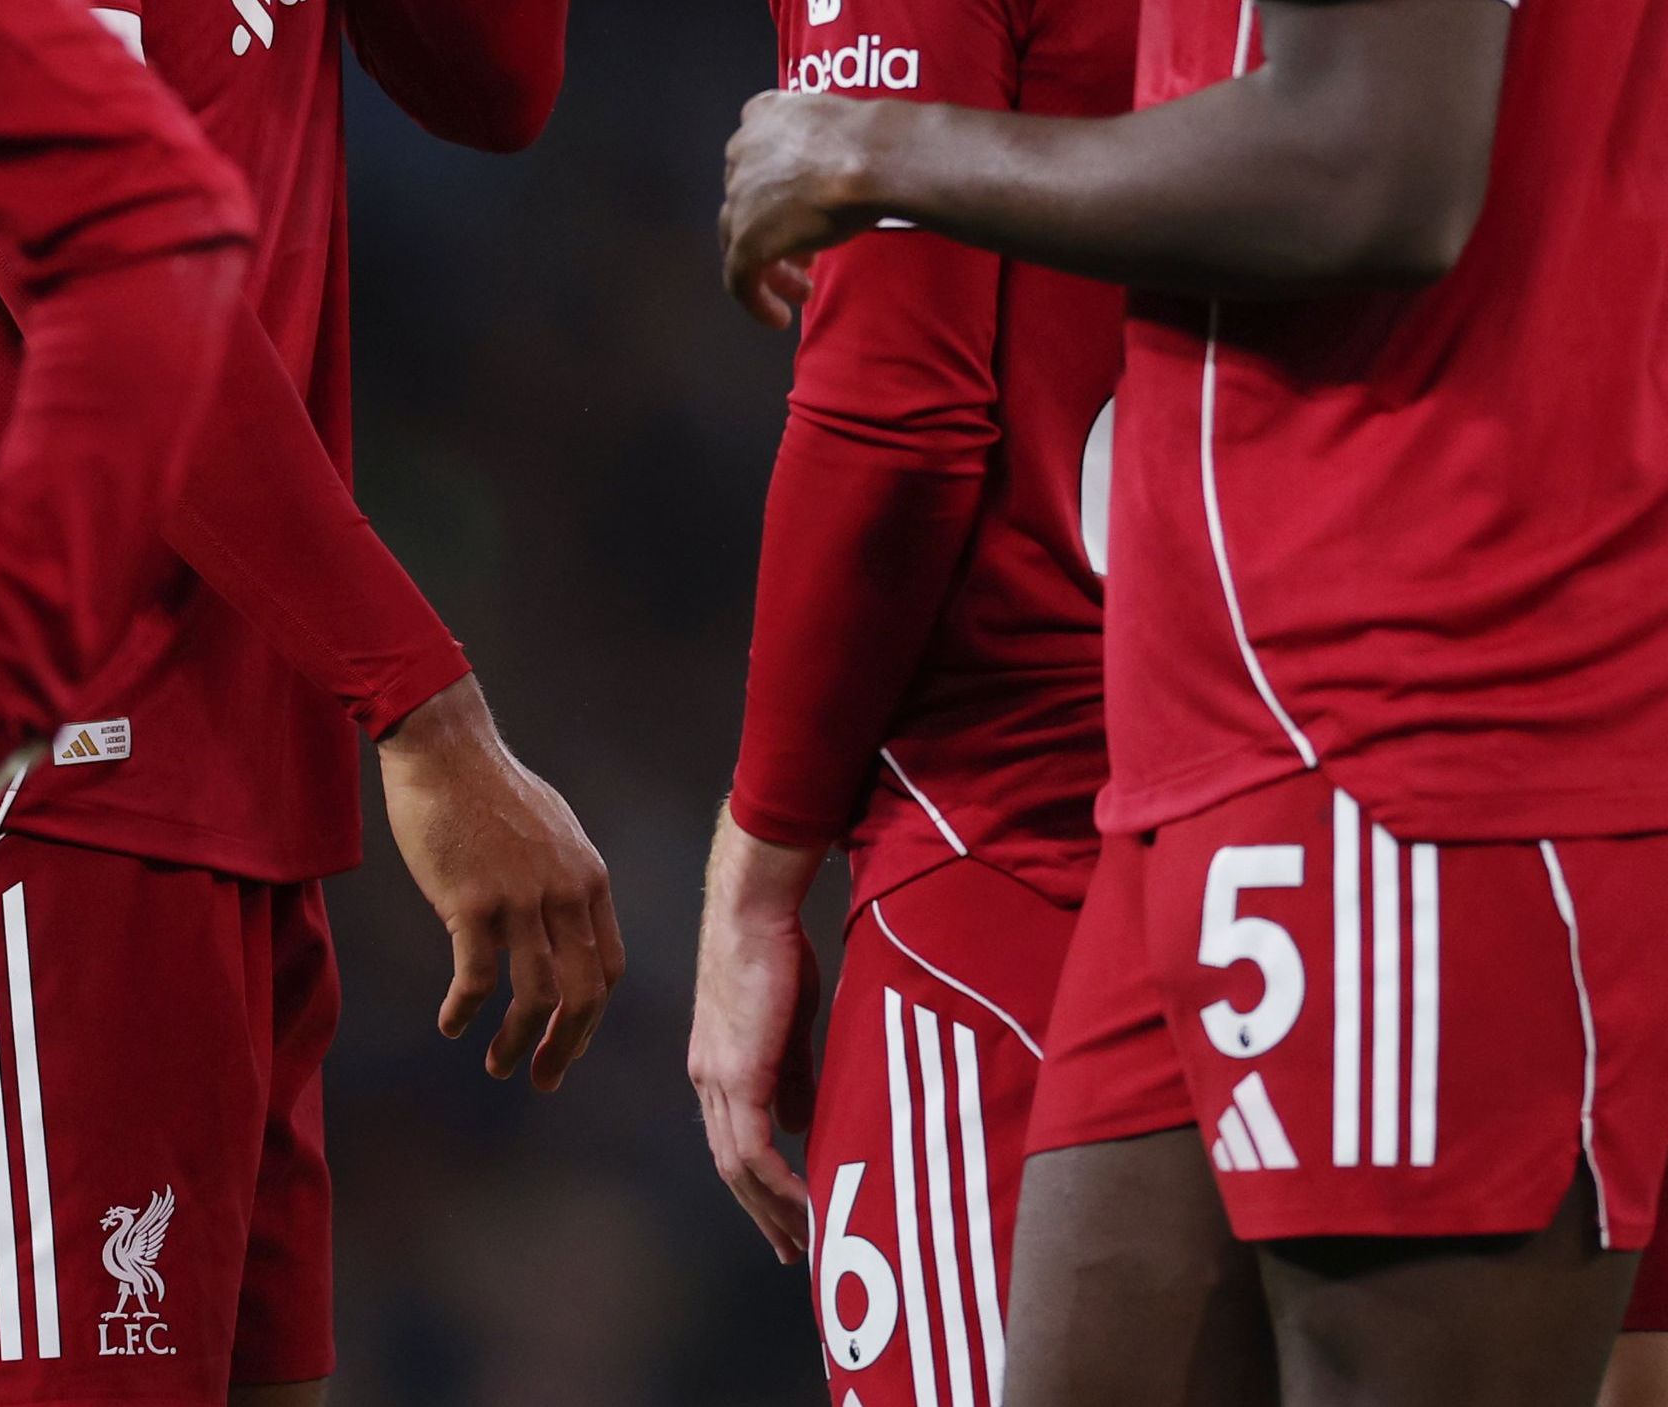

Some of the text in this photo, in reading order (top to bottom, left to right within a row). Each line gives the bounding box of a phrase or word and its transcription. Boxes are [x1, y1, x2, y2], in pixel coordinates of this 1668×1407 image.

[1198, 844, 1306, 1059] 5
[98, 1323, 177, 1356] L.F.C.
[807, 1161, 899, 1371] 6
